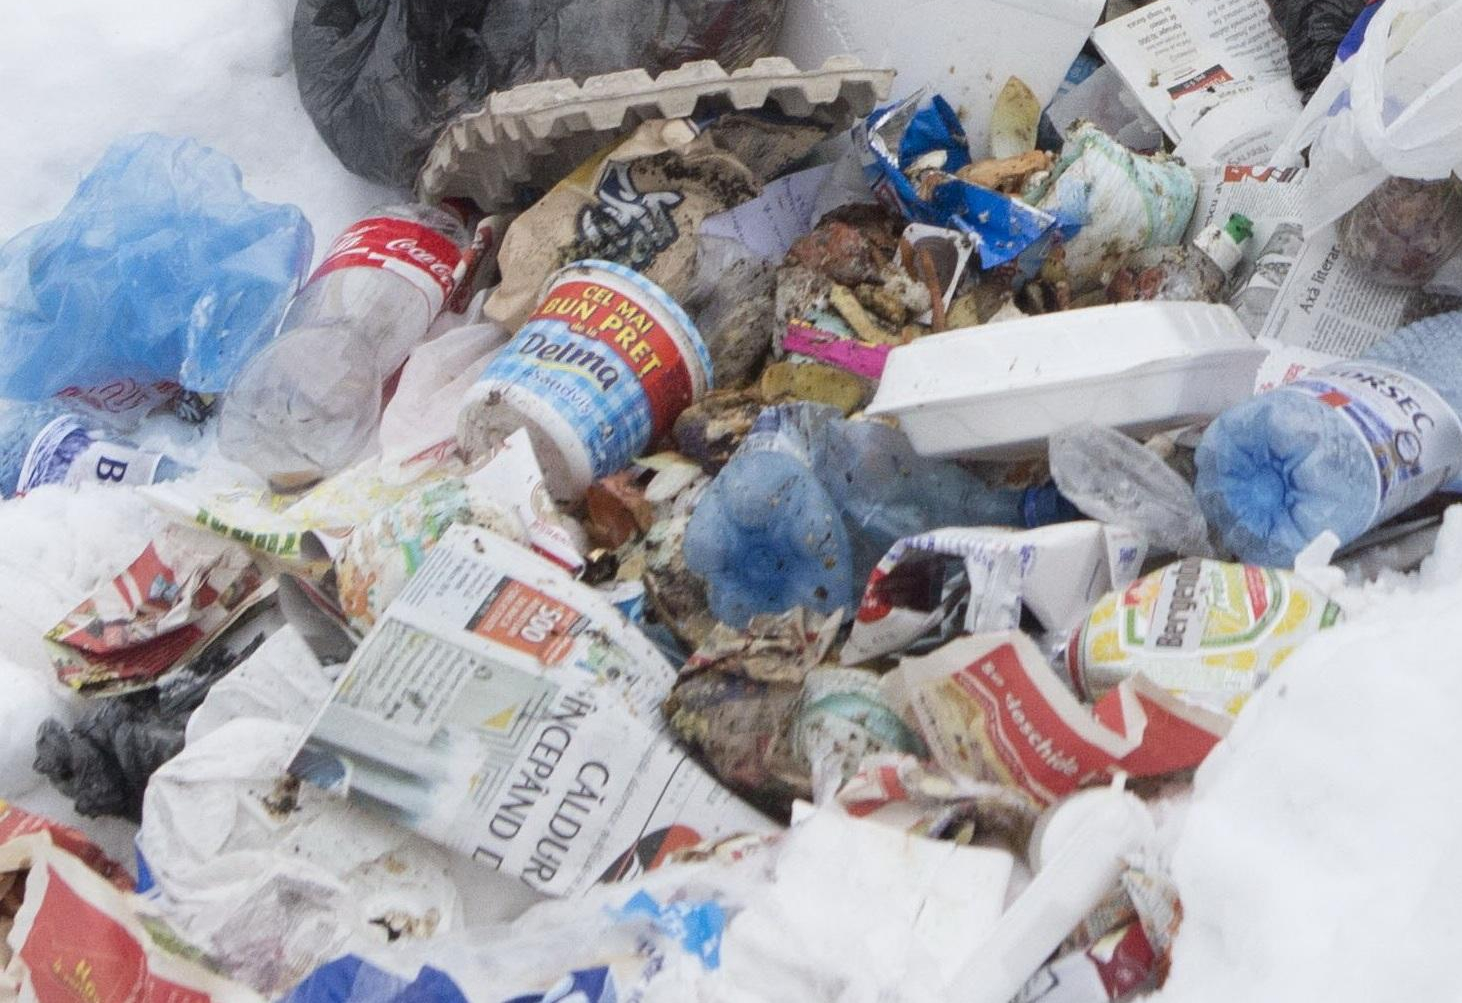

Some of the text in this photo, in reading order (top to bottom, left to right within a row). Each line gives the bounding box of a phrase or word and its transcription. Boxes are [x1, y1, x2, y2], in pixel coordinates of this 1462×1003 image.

[547, 297, 593, 328] BUN
[582, 285, 655, 335] CEL MAI
[518, 332, 619, 390] Delma
